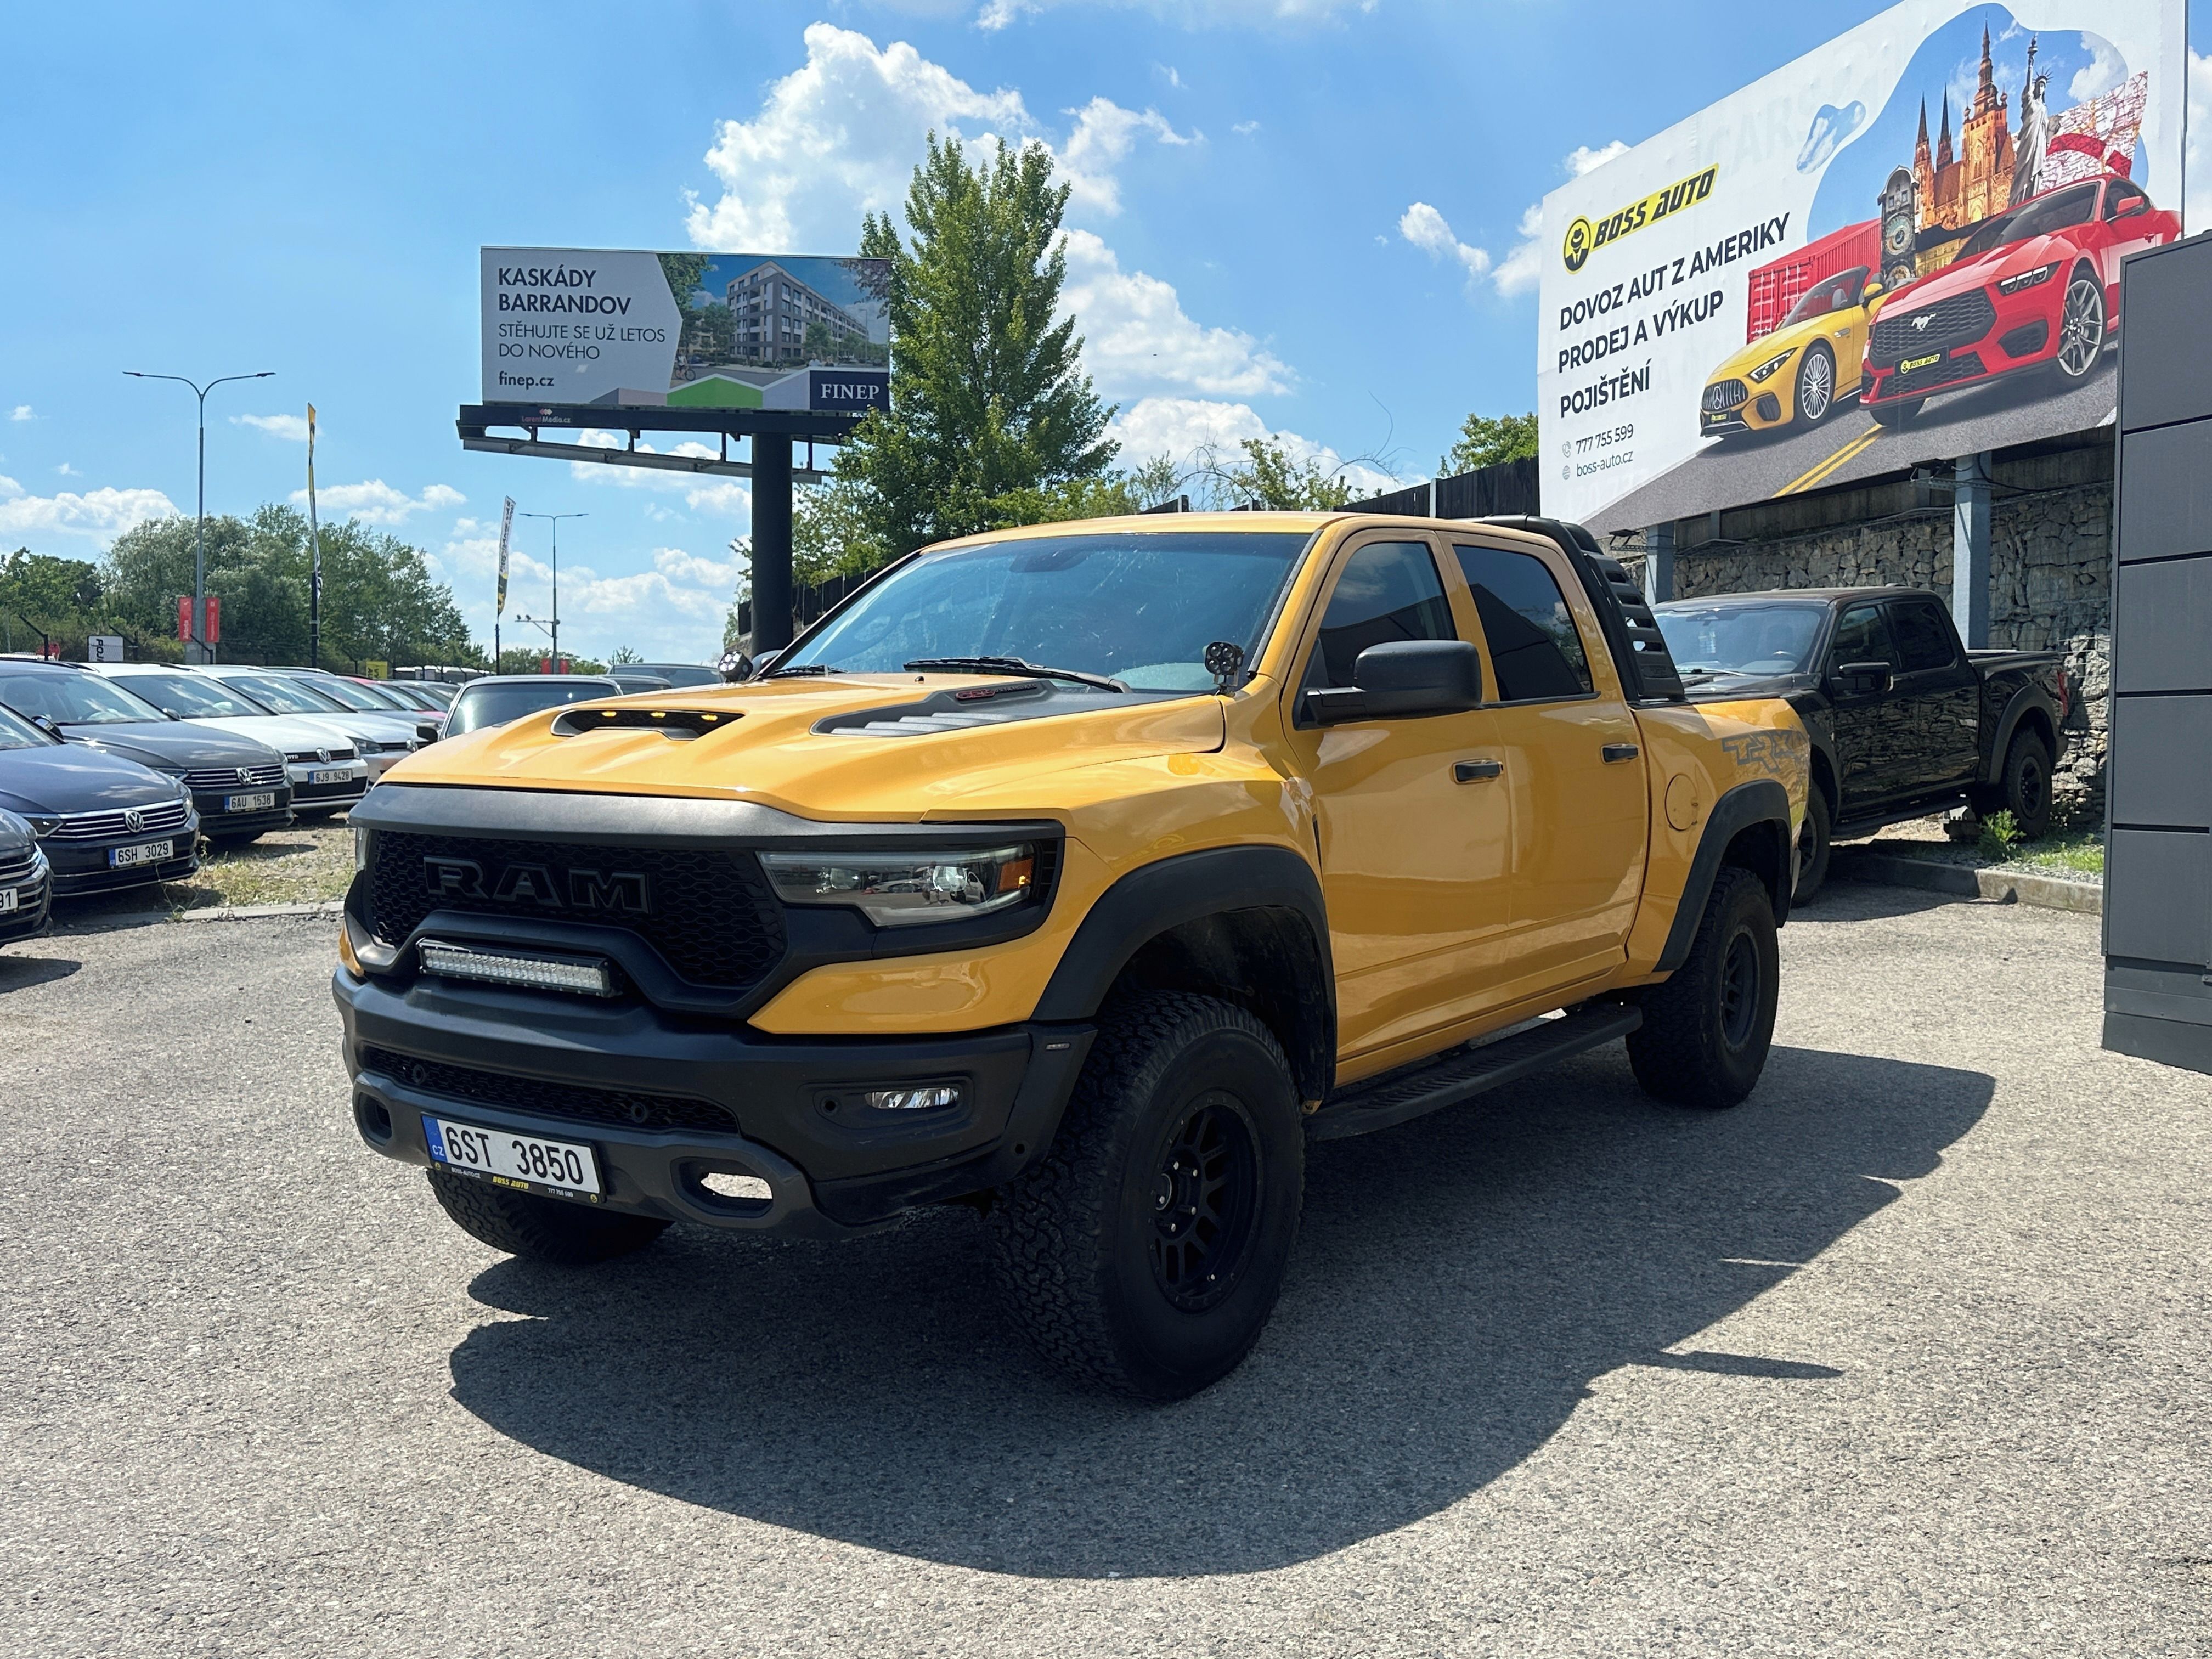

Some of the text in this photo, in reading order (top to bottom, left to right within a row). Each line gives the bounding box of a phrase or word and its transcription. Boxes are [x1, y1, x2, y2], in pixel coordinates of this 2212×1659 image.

[1593, 166, 1717, 249] BOSS AUTO
[498, 263, 596, 288] KASKÁDY
[1560, 212, 1790, 331] DOVOZ AUT Z AMERIKY
[499, 293, 631, 315] BARRANDOV
[498, 320, 665, 343] STĚHUJTE SE UŽ LETOS
[1559, 290, 1724, 374] PRODEJ A VÝKUP
[499, 341, 600, 360] DO NOVÉHO
[498, 370, 555, 391] finep.cz
[821, 384, 879, 399] FINEP
[1561, 358, 1652, 419] POJIŠTĚNÍ
[1576, 424, 1634, 454] 777 755 599
[1577, 450, 1633, 477] boss-auto.cz
[1721, 729, 1795, 774] TRX
[315, 771, 349, 782] 6J9 9428
[231, 794, 272, 809] 6AU 1538
[118, 843, 168, 863] 6SH 3029
[424, 856, 652, 913] RAM
[432, 1144, 445, 1156] CZ
[445, 1127, 584, 1185] 6ST 3850
